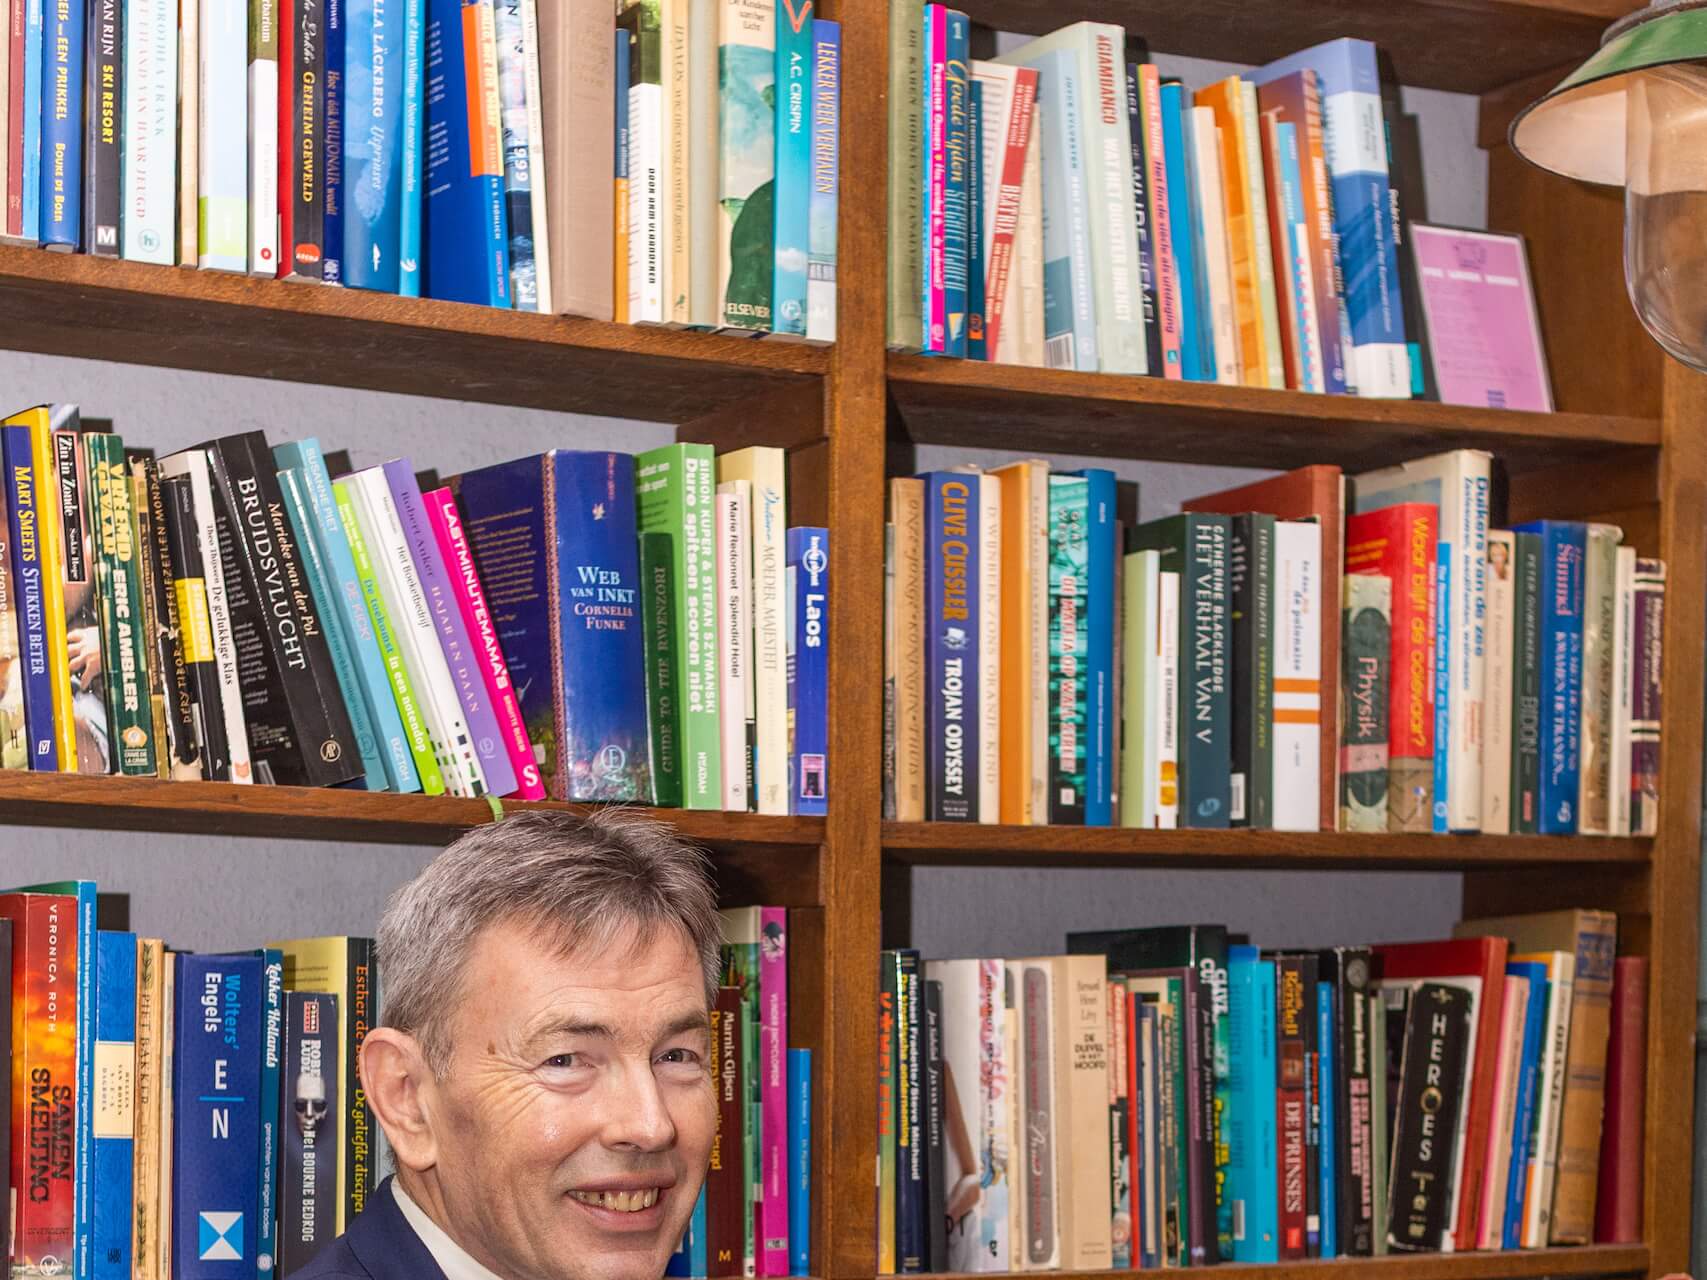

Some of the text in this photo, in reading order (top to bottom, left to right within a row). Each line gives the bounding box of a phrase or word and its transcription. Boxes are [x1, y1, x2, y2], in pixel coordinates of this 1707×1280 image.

[55, 37, 67, 62] EEN
[101, 24, 115, 145] RIJN SKI RESORT
[327, 70, 340, 89] Hoe
[372, 34, 389, 118] LÄCKBERG
[406, 30, 420, 57] Harry
[55, 66, 68, 120] PRIKKEL
[303, 70, 315, 135] GEHEIM
[789, 52, 803, 134] A.C. CRISPIN
[815, 41, 838, 194] LEKKER WEER VERHALEN
[944, 59, 970, 127] Goede
[54, 142, 66, 176] BOUKE
[54, 179, 65, 192] DE
[301, 138, 314, 202] GEWELD
[993, 184, 1021, 235] BEATRIX
[1162, 275, 1177, 335] uitdaging
[58, 437, 80, 581] Zin in Zonde Saskia Hope
[97, 460, 116, 558] GEVAAR
[305, 446, 339, 534] SUSANNE PIET
[14, 465, 45, 676] MART SMEETS STUKKEN BETER
[109, 462, 140, 713] VREEMD ERIC AMBLER
[237, 476, 308, 671] BRUIDSVLUCHT
[266, 501, 320, 637] Marieke van der Pol
[395, 545, 409, 563] Het
[576, 566, 621, 585] WEB
[683, 457, 704, 713] Dure spitsen scoren niet
[699, 458, 716, 714] SIMON KUPER & STEFAN SZYMANSKI
[728, 500, 741, 679] Marie Redonnet Splendid Hotel
[941, 481, 970, 621] CLIVE CUSSLER
[1474, 476, 1488, 619] Duikers van de
[191, 582, 210, 658] SIMENON
[206, 523, 235, 686] Theo De gelukkige klas
[399, 490, 480, 714] Robert Anker HAJAR EN DAAN
[441, 502, 512, 690] LASTMINUTEMAMA'S
[570, 587, 635, 604] VAN INKT
[585, 616, 626, 631] FUNKE
[806, 593, 826, 648] Laos
[1195, 524, 1213, 744] HET VERHAAL VAN V
[1212, 525, 1225, 694] CATHERINE BLACKLEDGE
[1408, 516, 1431, 747] Waar blijft de ooievaar?
[363, 579, 427, 754] De toekomst in een notendop
[654, 567, 674, 774] GUIDE TO THE RWENZORI
[1062, 680, 1077, 720] WALL
[1353, 656, 1378, 738] Physik
[1519, 553, 1539, 755] PETER BIDON
[941, 657, 964, 796] TROJAN ODYSSEY
[1061, 722, 1077, 774] STREET
[47, 903, 58, 1034] VERONICA ROTH
[201, 972, 222, 1034] Engels
[265, 962, 282, 1069] Lekker Hollands
[908, 973, 919, 1024] Michael
[1284, 970, 1299, 1036] Rendell
[351, 965, 369, 1161] Esther de De geliefde
[711, 1011, 721, 1028] De
[721, 1011, 736, 1102] Marnix Gijsen
[1074, 1060, 1106, 1070] HOOFD
[215, 1059, 229, 1091] E
[1418, 1012, 1448, 1162] HEROES
[29, 1067, 51, 1204] SMELTING
[50, 1084, 73, 1185] SAMEN
[212, 1108, 229, 1139] N
[910, 1125, 921, 1181] Michaud
[1284, 1101, 1302, 1214] DE PRINSES
[261, 1122, 273, 1239] gerechten van eigen bodem
[301, 1130, 316, 1242] Het BOURNE BEDROG
